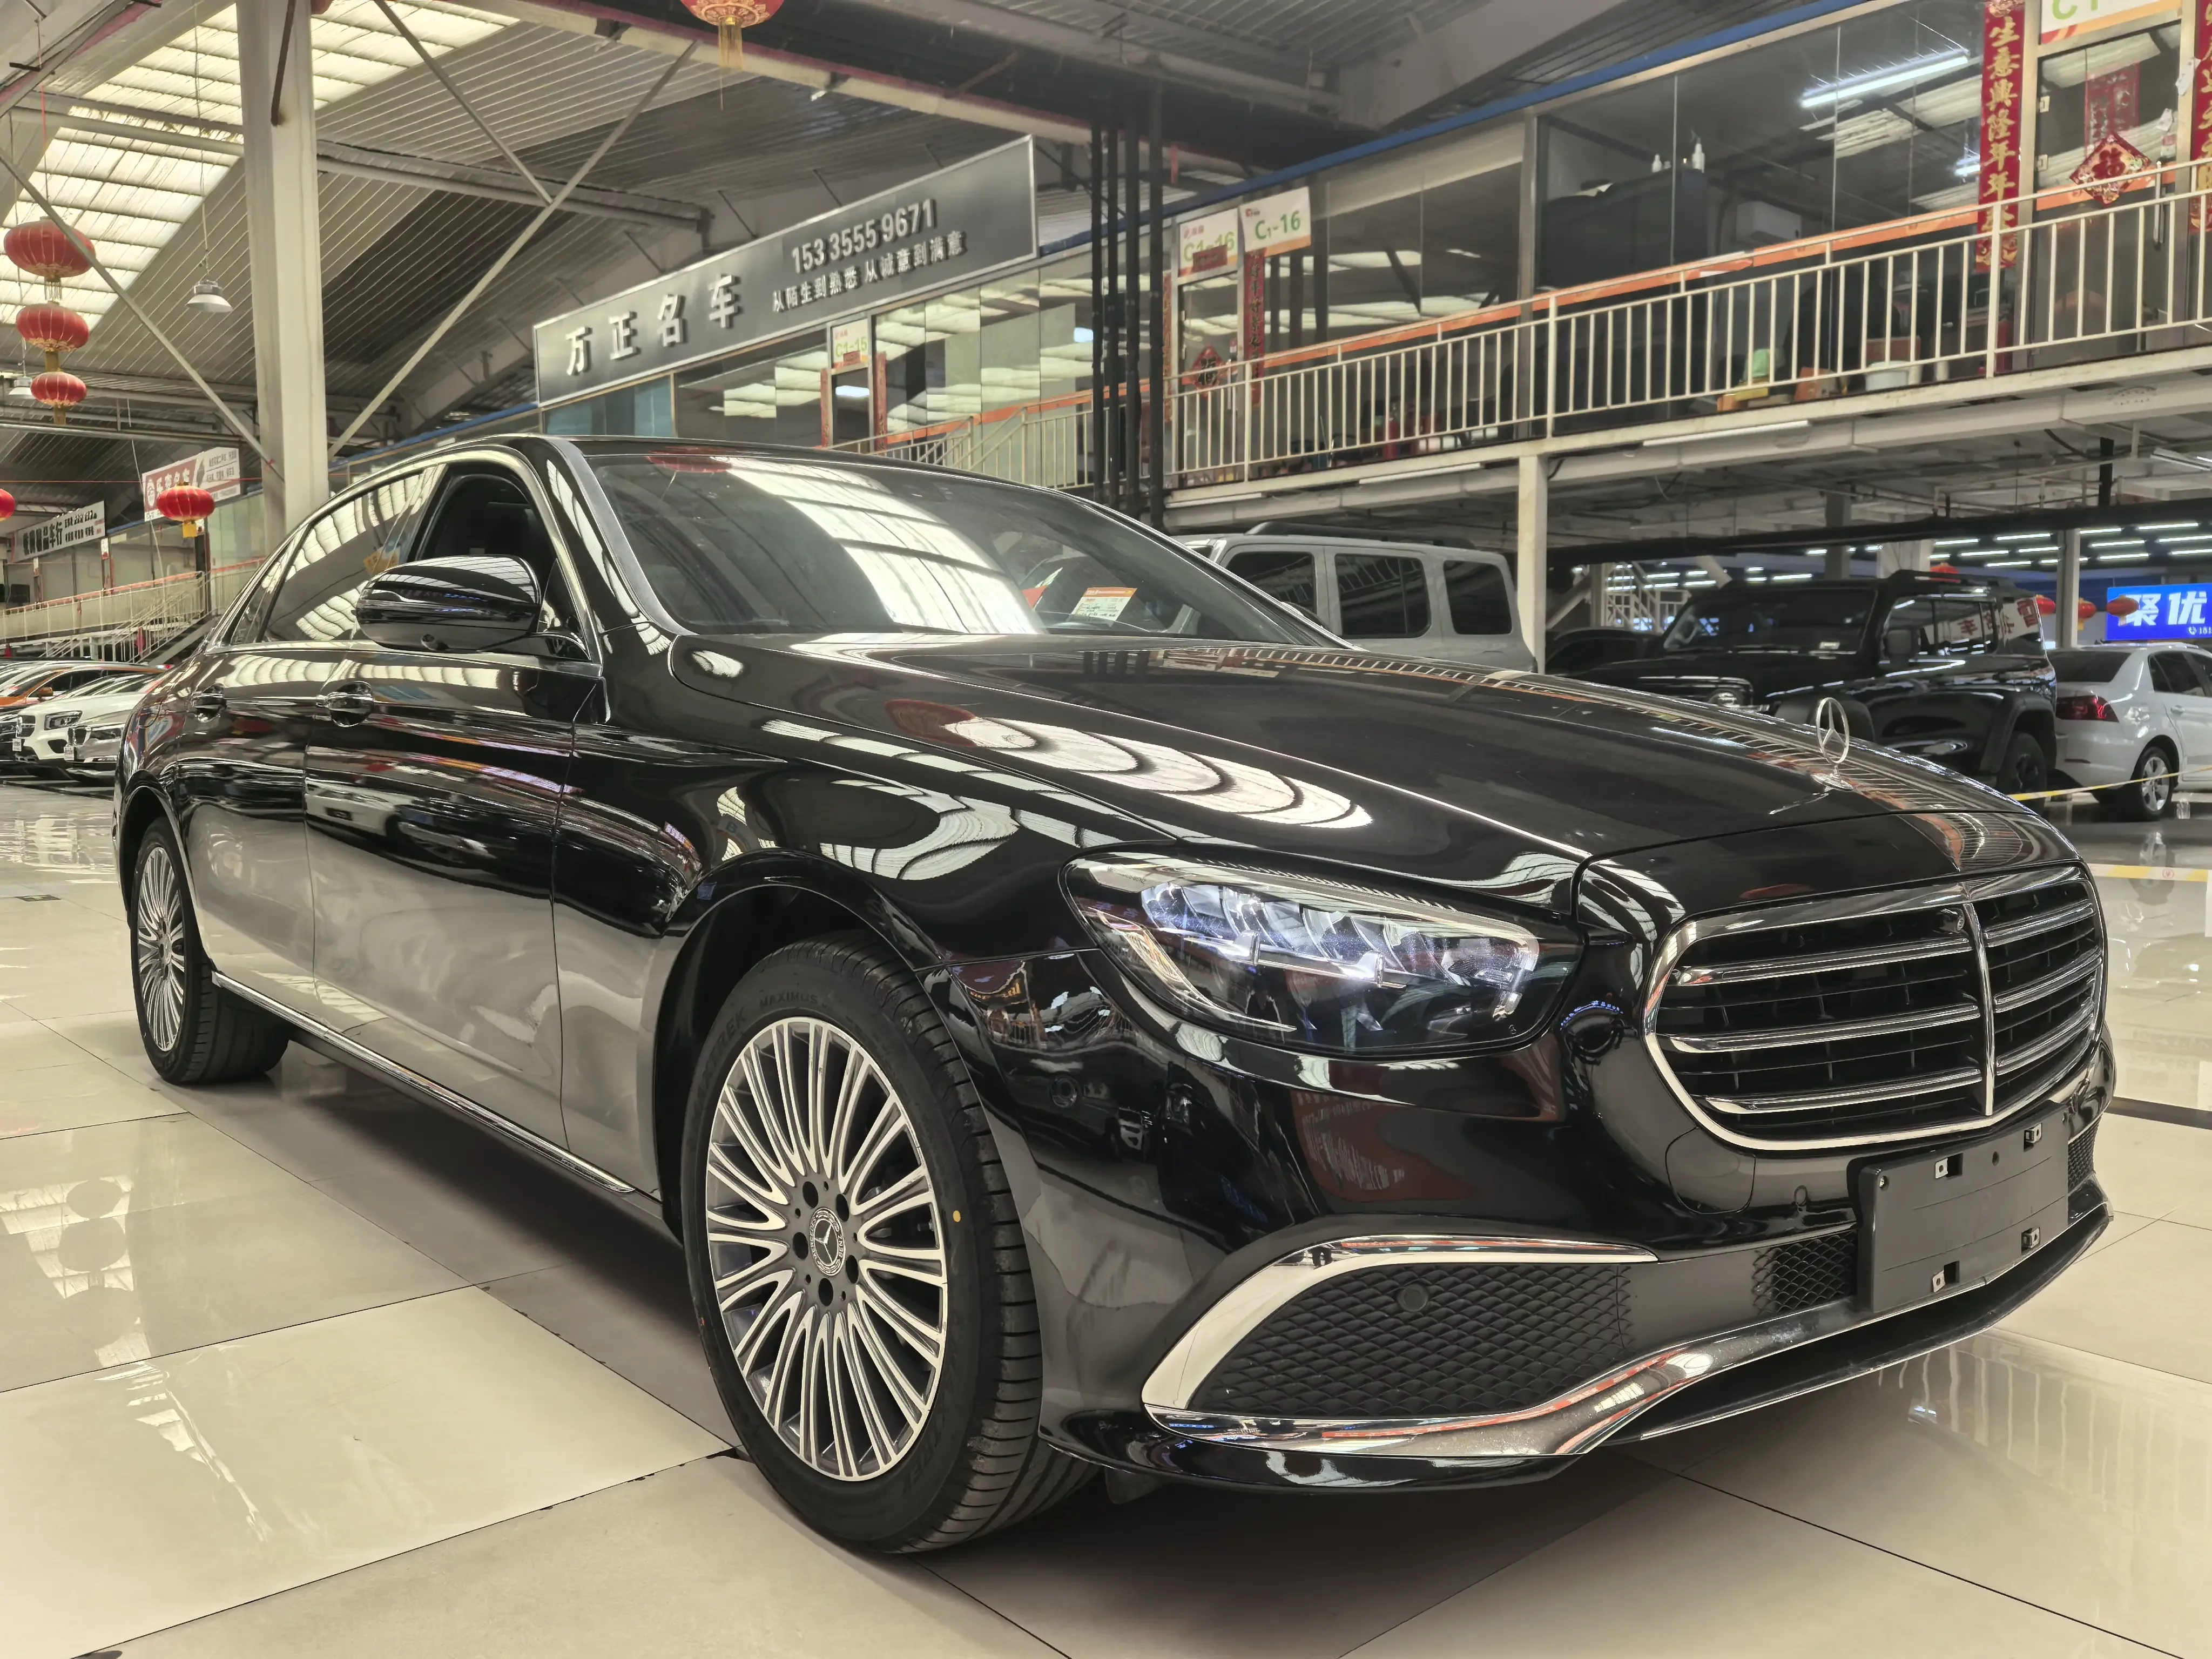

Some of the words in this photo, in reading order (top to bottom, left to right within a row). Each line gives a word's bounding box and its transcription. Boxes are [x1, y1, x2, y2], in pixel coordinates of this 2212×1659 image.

[791, 238, 826, 274] 153
[829, 219, 878, 261] 3555
[881, 198, 933, 242] 9671
[772, 265, 861, 313] 从陌生到熟悉
[759, 991, 819, 1010] MAXIMUS
